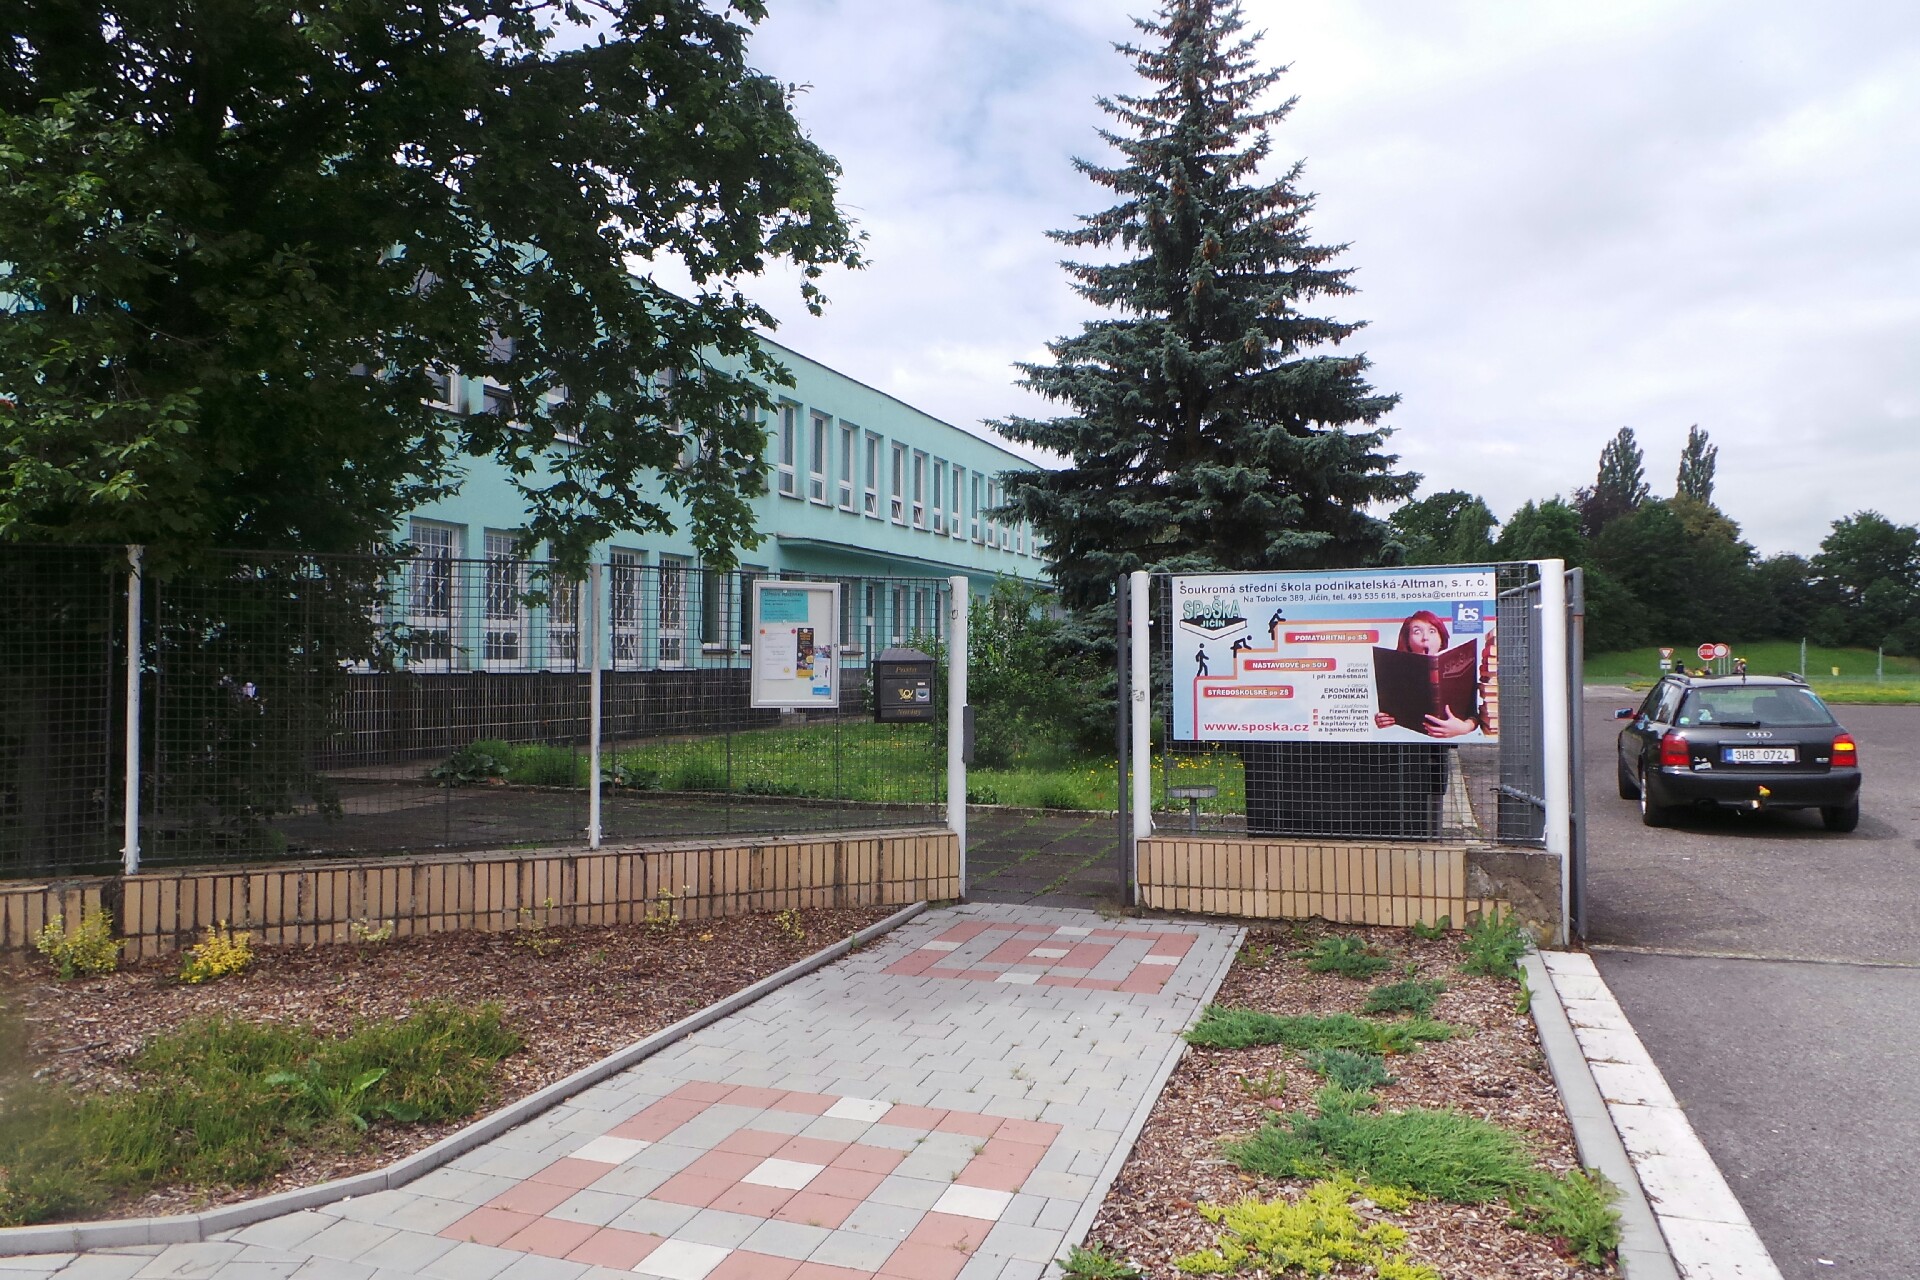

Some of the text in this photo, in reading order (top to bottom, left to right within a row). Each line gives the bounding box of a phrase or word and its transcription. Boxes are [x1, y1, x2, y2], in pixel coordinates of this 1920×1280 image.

[1180, 584, 1235, 594] Soukromá
[1239, 583, 1278, 593] střední
[1281, 582, 1311, 592] škola
[1315, 579, 1448, 594] podnikatelská-Altman,
[1401, 590, 1489, 599] sposka@centrum.cz
[1458, 603, 1479, 621] ies
[1204, 722, 1309, 734] www.sposka.cz
[1763, 750, 1789, 760] 0724
